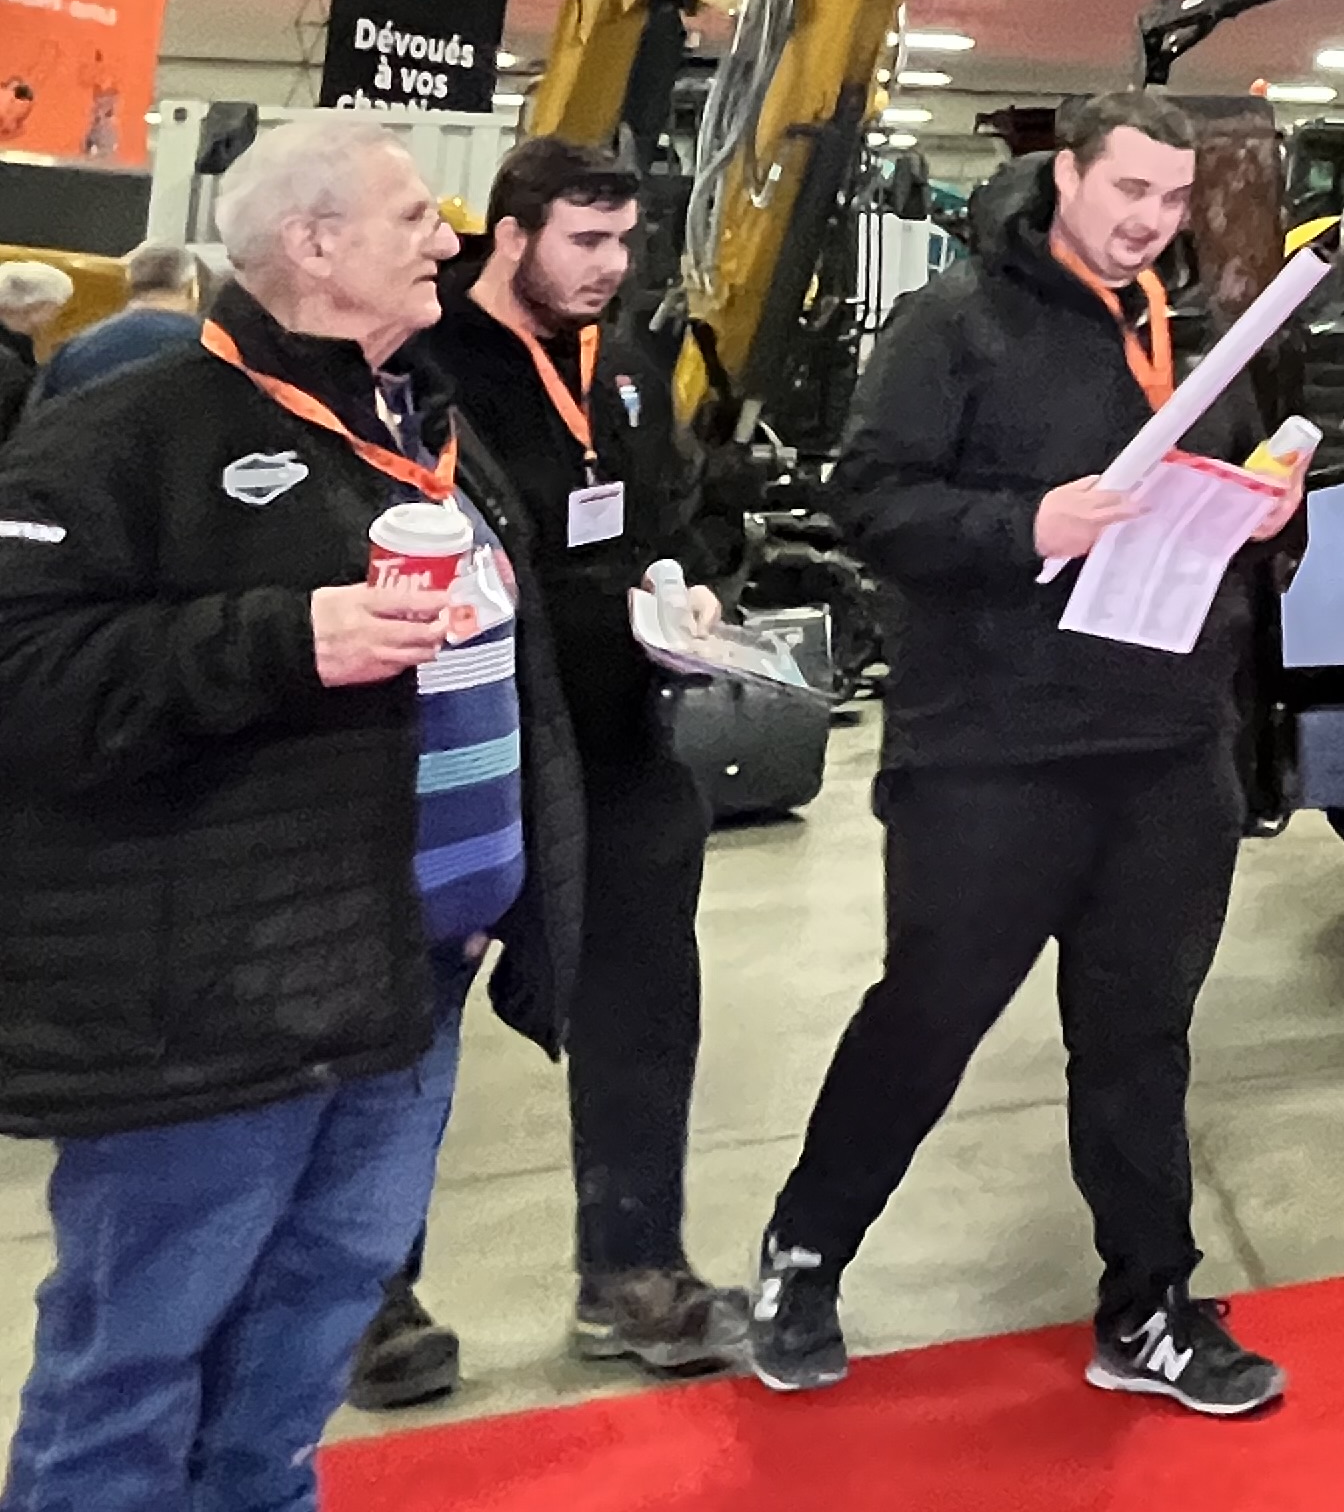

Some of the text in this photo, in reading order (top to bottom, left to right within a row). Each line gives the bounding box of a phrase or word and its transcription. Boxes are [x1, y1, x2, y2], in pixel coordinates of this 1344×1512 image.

[354, 17, 475, 69] Dévoués
[374, 54, 449, 99] à vos
